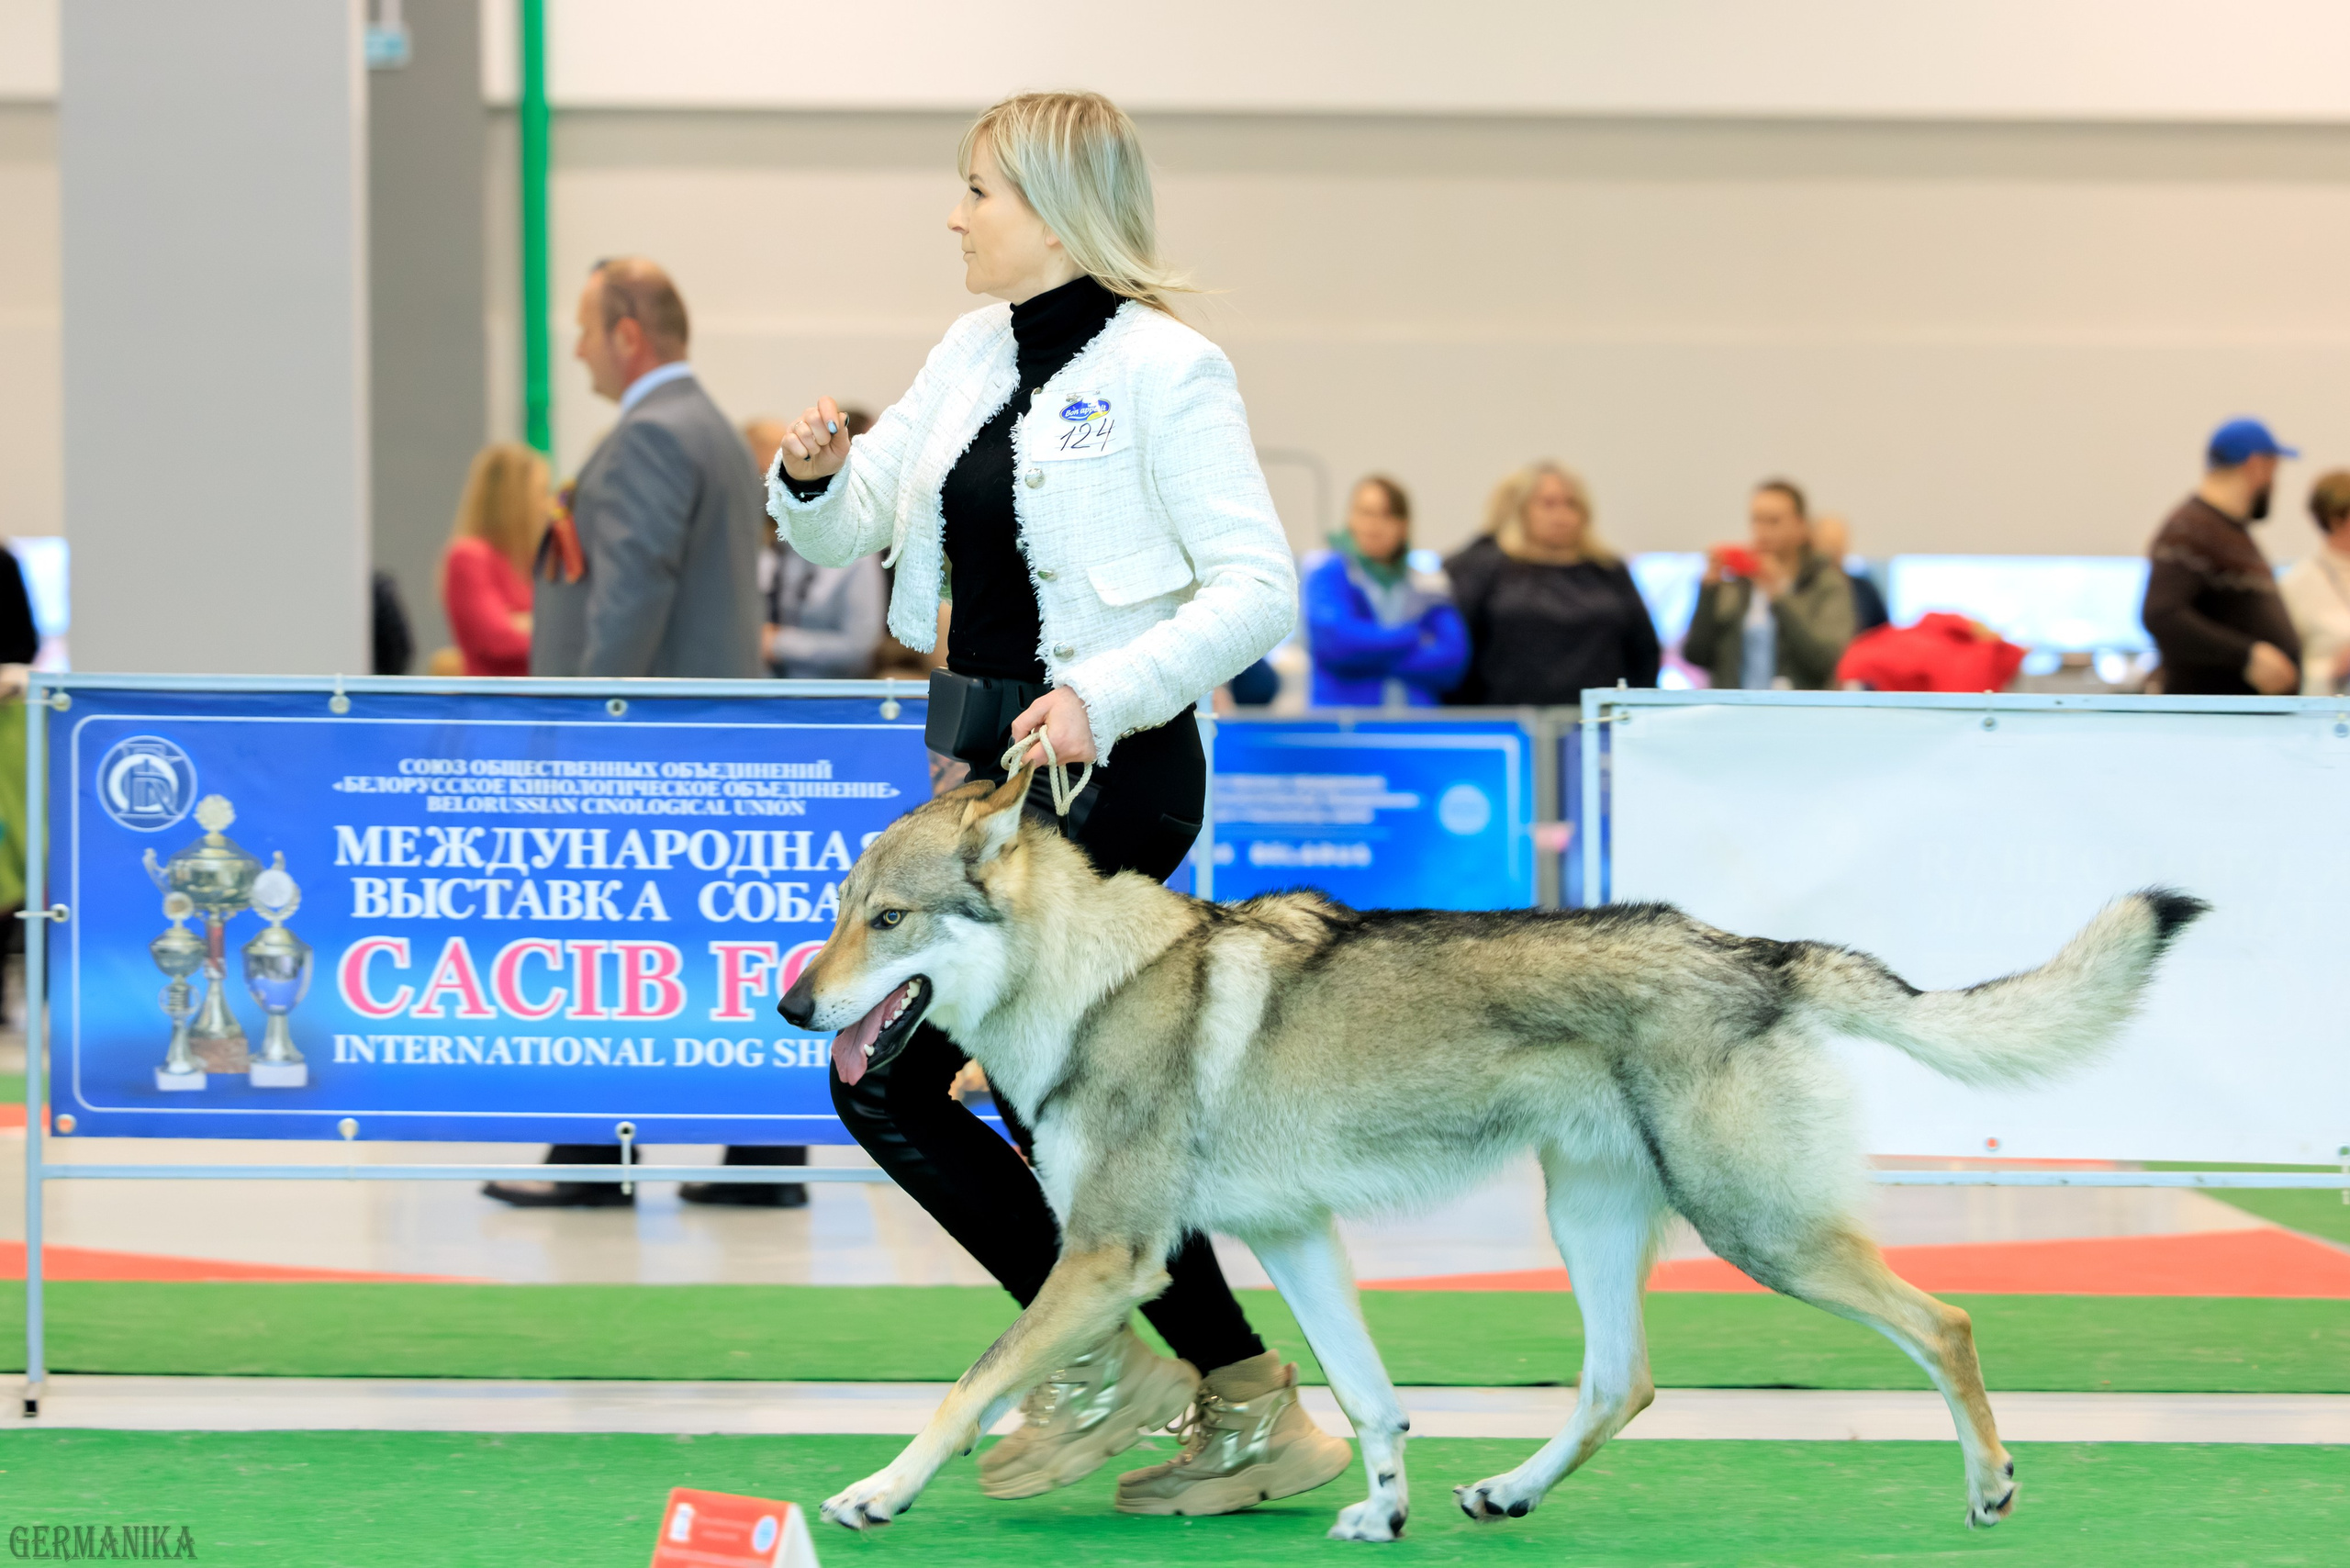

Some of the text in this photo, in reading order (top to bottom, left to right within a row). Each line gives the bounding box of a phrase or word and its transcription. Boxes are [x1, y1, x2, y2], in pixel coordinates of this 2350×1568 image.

[1065, 409, 1080, 417] Bon
[1060, 418, 1114, 452] 124
[398, 758, 834, 780] СОЮЗ ОБЩЕСТВЕННЫХ ОБЪЕДИНЕНИЙ
[332, 776, 901, 799] «БЕЛОРУССКОЕ КИНОЛОГИЧЕСКОЕ ОБЪЕДИНЕНИЕ»
[427, 795, 806, 816] BELORUSSIAN CINOLOGICAL UNION
[351, 878, 671, 922] ВЫСТАВКА
[337, 935, 688, 1021] CACIB
[332, 1033, 834, 1069] INTERNATIONAL DOG SH
